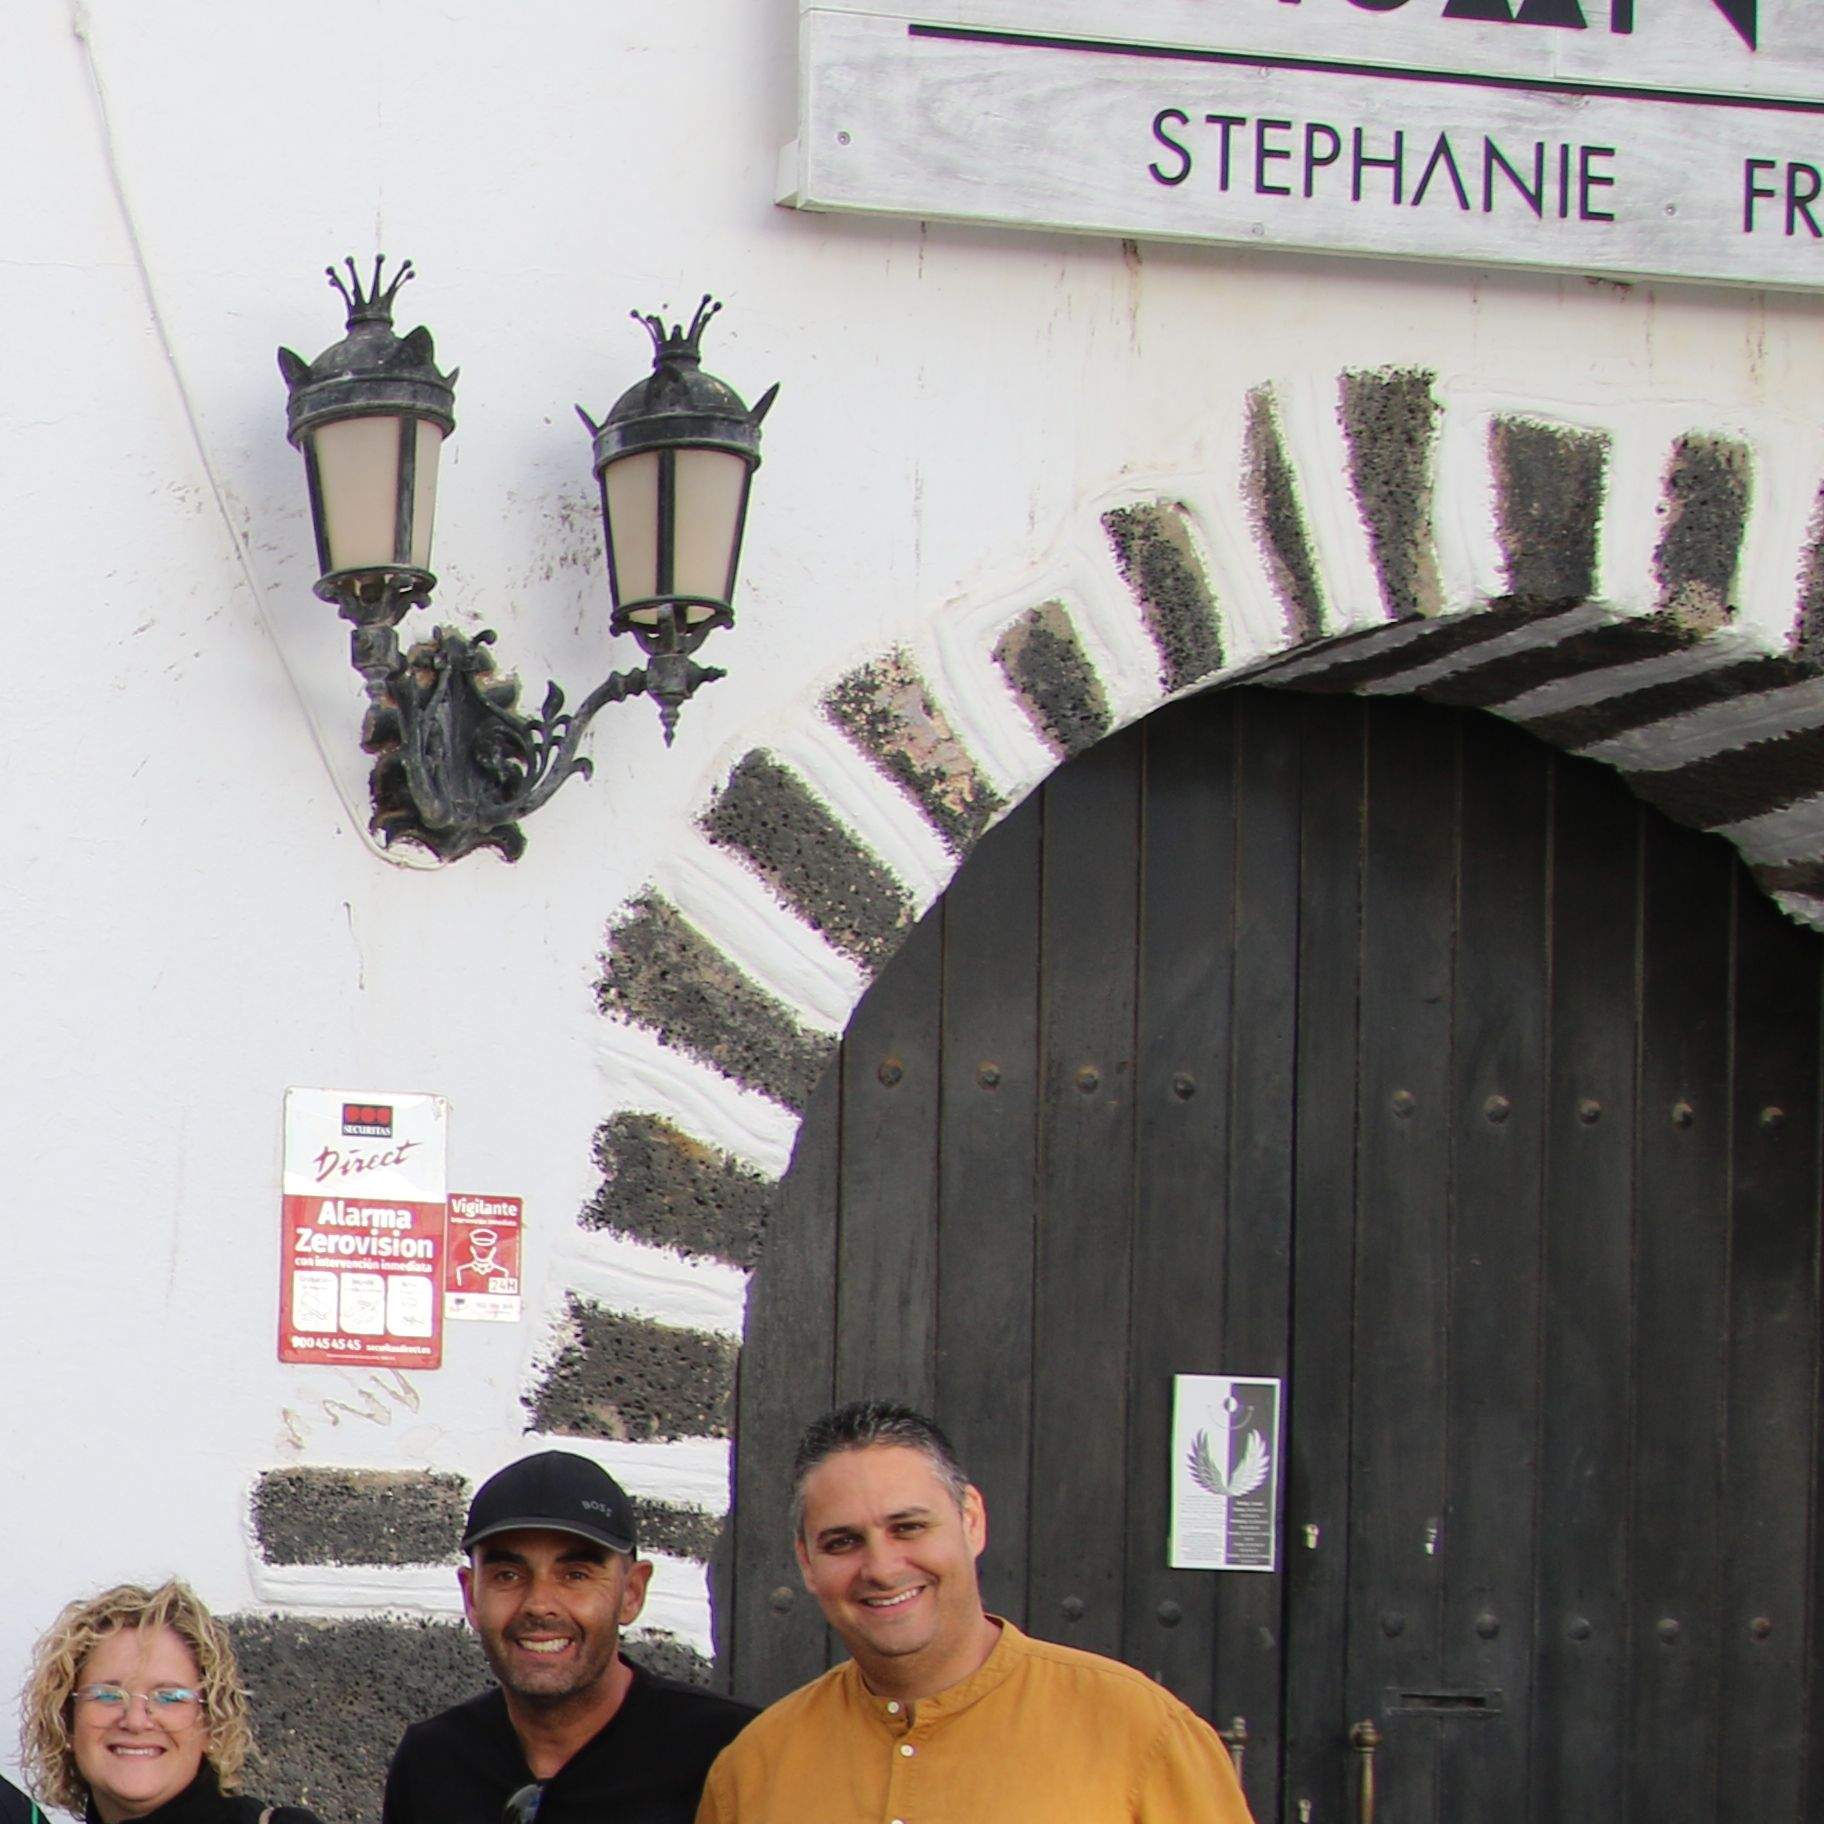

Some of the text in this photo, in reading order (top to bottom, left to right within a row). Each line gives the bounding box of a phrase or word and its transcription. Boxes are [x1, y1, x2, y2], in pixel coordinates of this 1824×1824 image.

[1148, 107, 1616, 221] STEPHANIE
[343, 1125, 392, 1136] SECURITAS
[313, 1140, 423, 1182] Direct
[317, 1200, 412, 1230] Alarma
[452, 1197, 518, 1218] Vigilante
[295, 1227, 434, 1259] Zerovision
